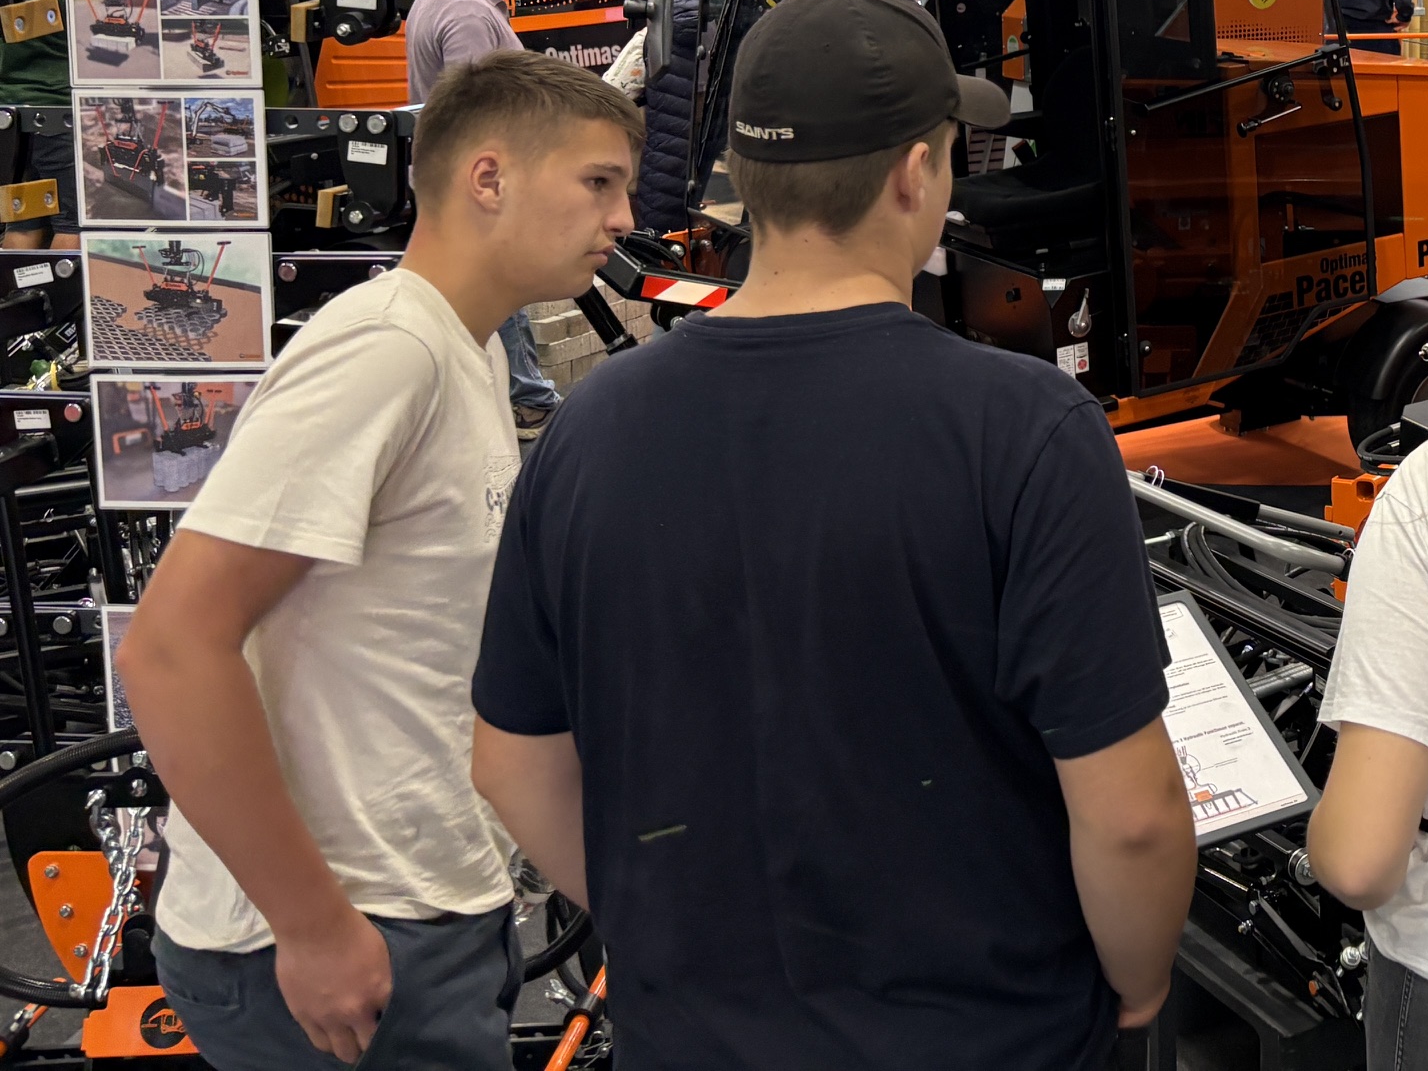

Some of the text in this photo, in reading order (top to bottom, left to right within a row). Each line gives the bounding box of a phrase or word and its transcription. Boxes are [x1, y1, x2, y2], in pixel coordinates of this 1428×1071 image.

[736, 120, 795, 141] SAINTS
[1320, 252, 1368, 275] Optima
[1296, 269, 1370, 306] Pace
